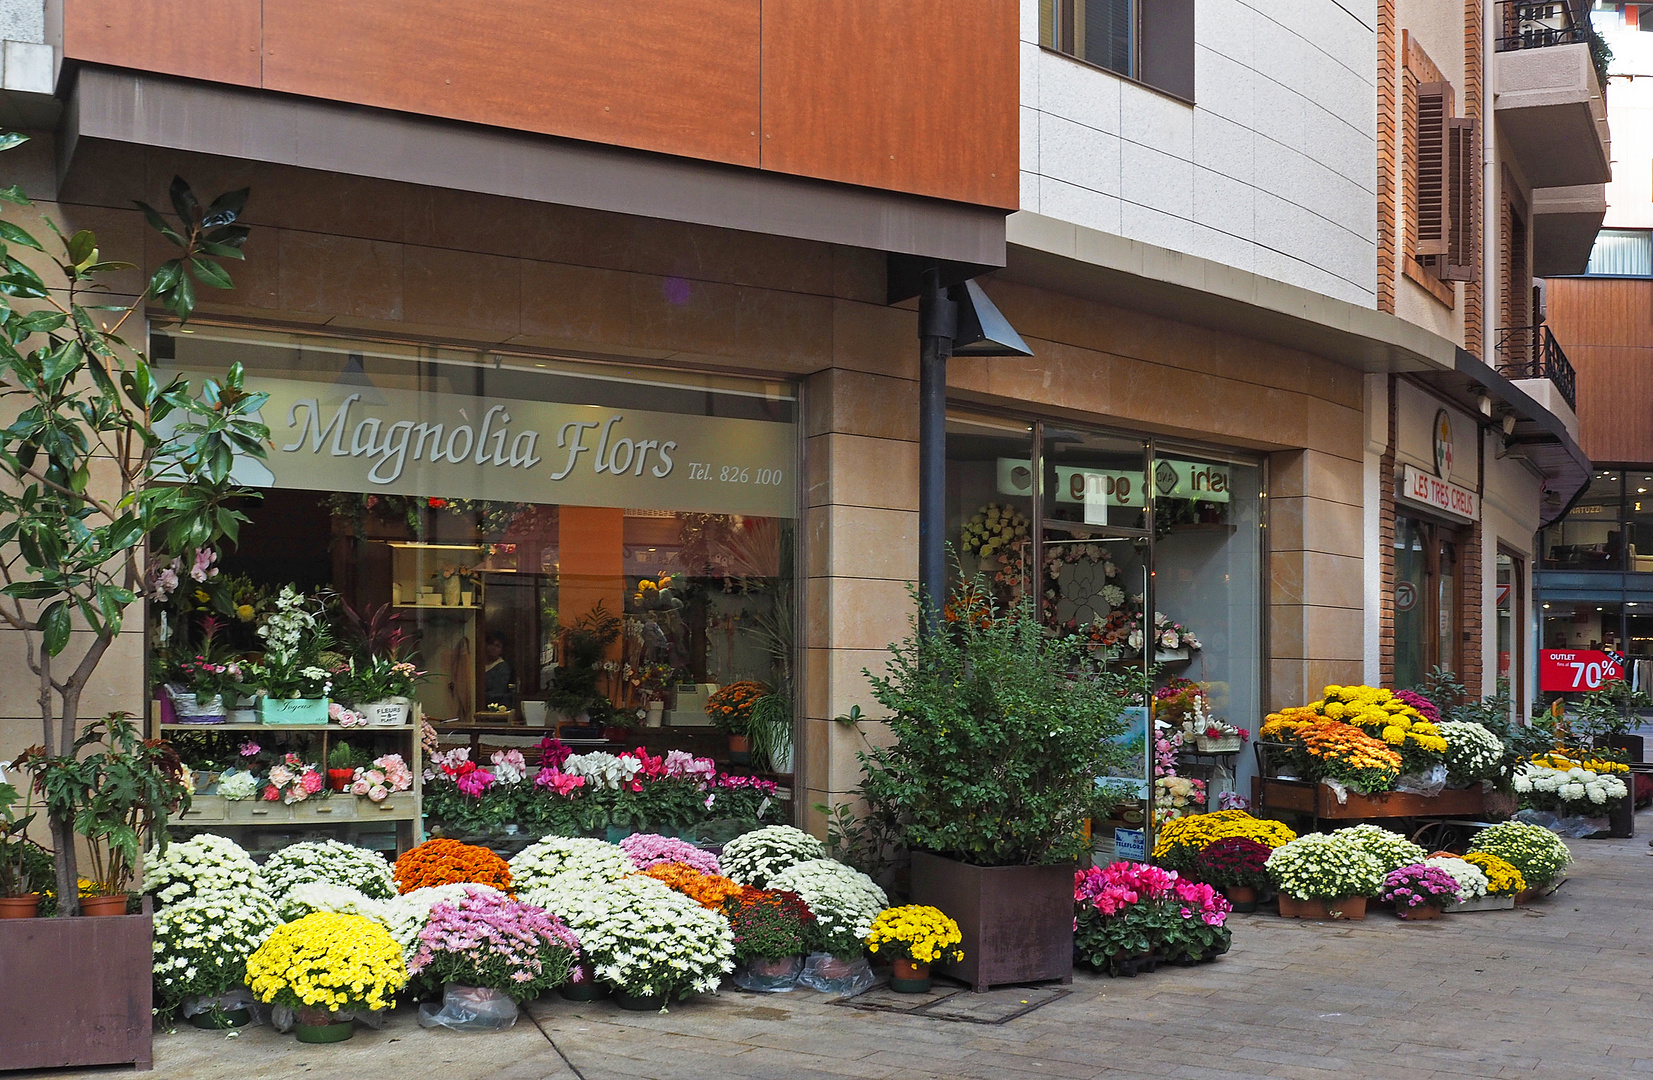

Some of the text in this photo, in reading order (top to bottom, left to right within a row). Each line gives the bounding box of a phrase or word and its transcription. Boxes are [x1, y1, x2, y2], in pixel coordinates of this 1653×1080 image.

[283, 392, 676, 484] Magnòlia Flors
[687, 461, 783, 487] Tel. 826 100
[1414, 473, 1473, 515] LES TRES CREUS
[1570, 506, 1602, 514] NATUZZI
[1570, 660, 1615, 688] 70%
[1116, 841, 1144, 850] TELEFLORA
